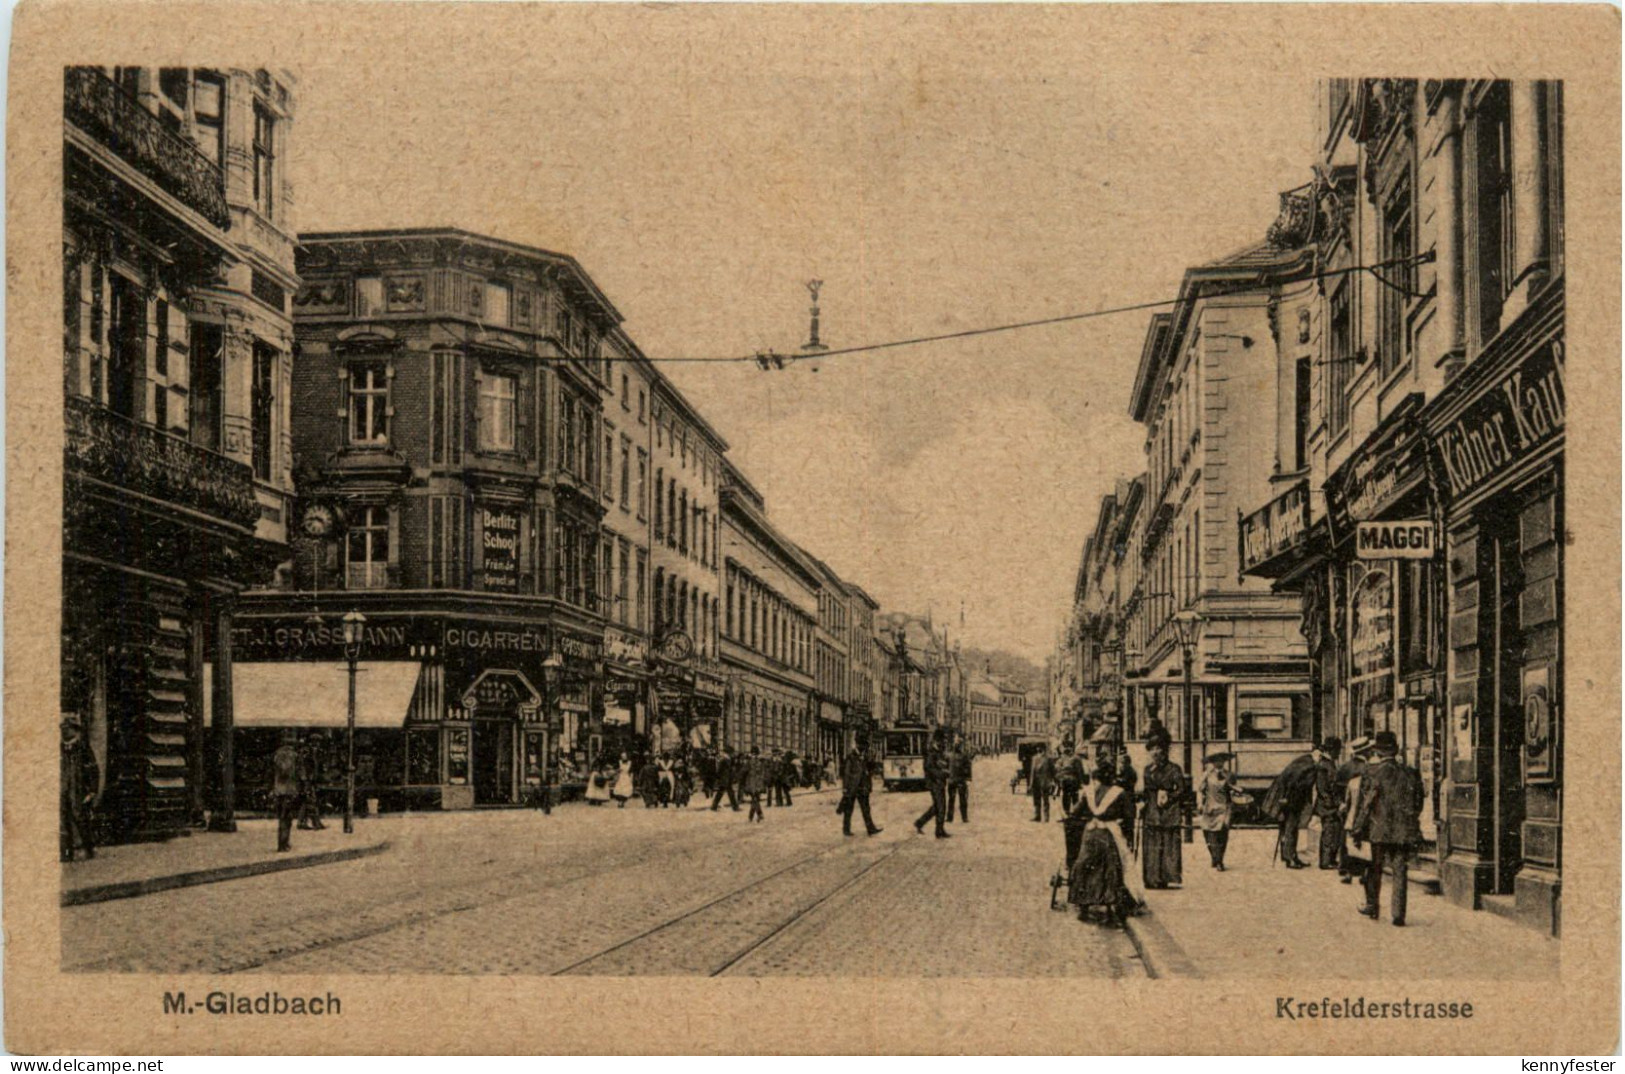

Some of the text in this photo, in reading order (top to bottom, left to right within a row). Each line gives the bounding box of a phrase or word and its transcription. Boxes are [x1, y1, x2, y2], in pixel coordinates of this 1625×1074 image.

[1437, 412, 1512, 497] Kölner
[484, 511, 517, 530] Berlitz
[484, 531, 517, 551] School
[274, 627, 405, 647] GRASSANN
[447, 629, 546, 651] CIGARREN
